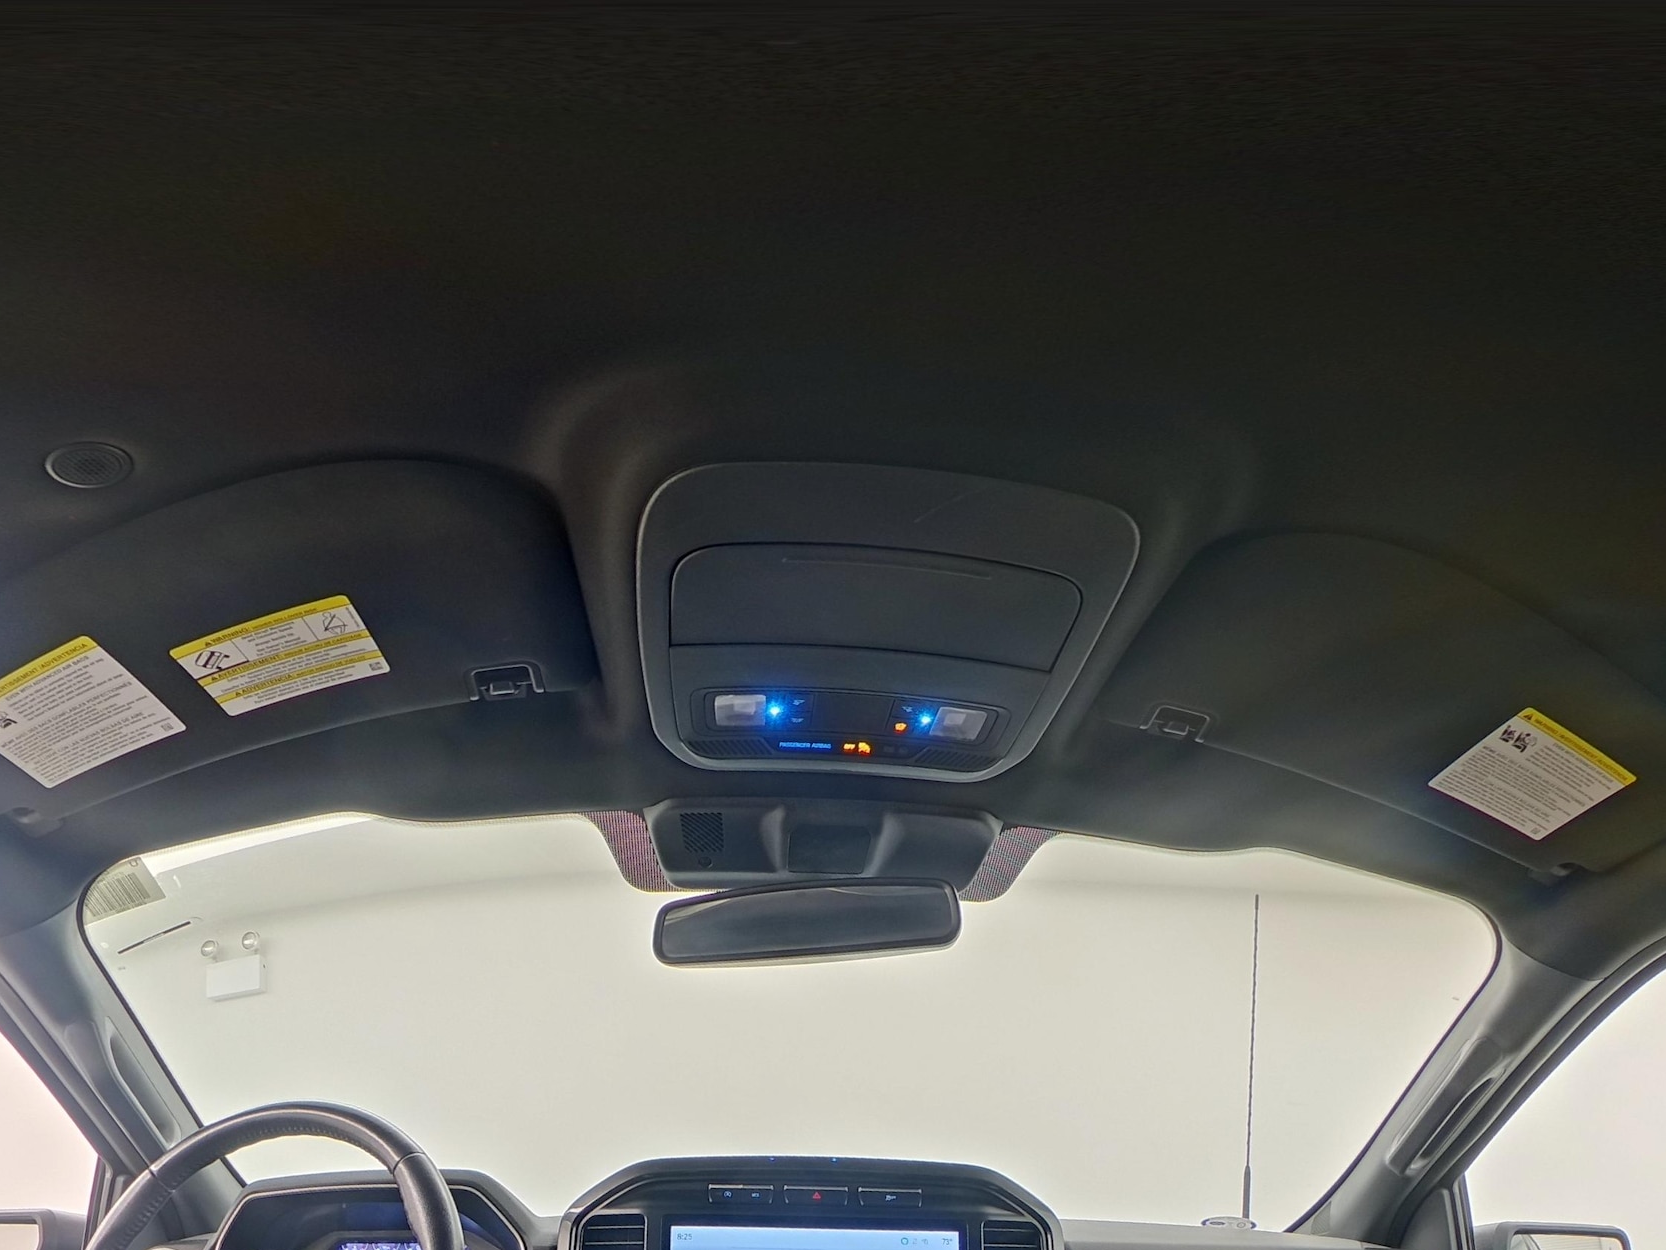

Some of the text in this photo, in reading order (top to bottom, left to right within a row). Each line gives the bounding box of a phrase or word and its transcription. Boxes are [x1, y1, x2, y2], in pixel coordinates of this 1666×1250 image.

[778, 741, 811, 749] PASSENGER
[811, 742, 832, 750] AIRBAG
[676, 1233, 693, 1241] 8:25
